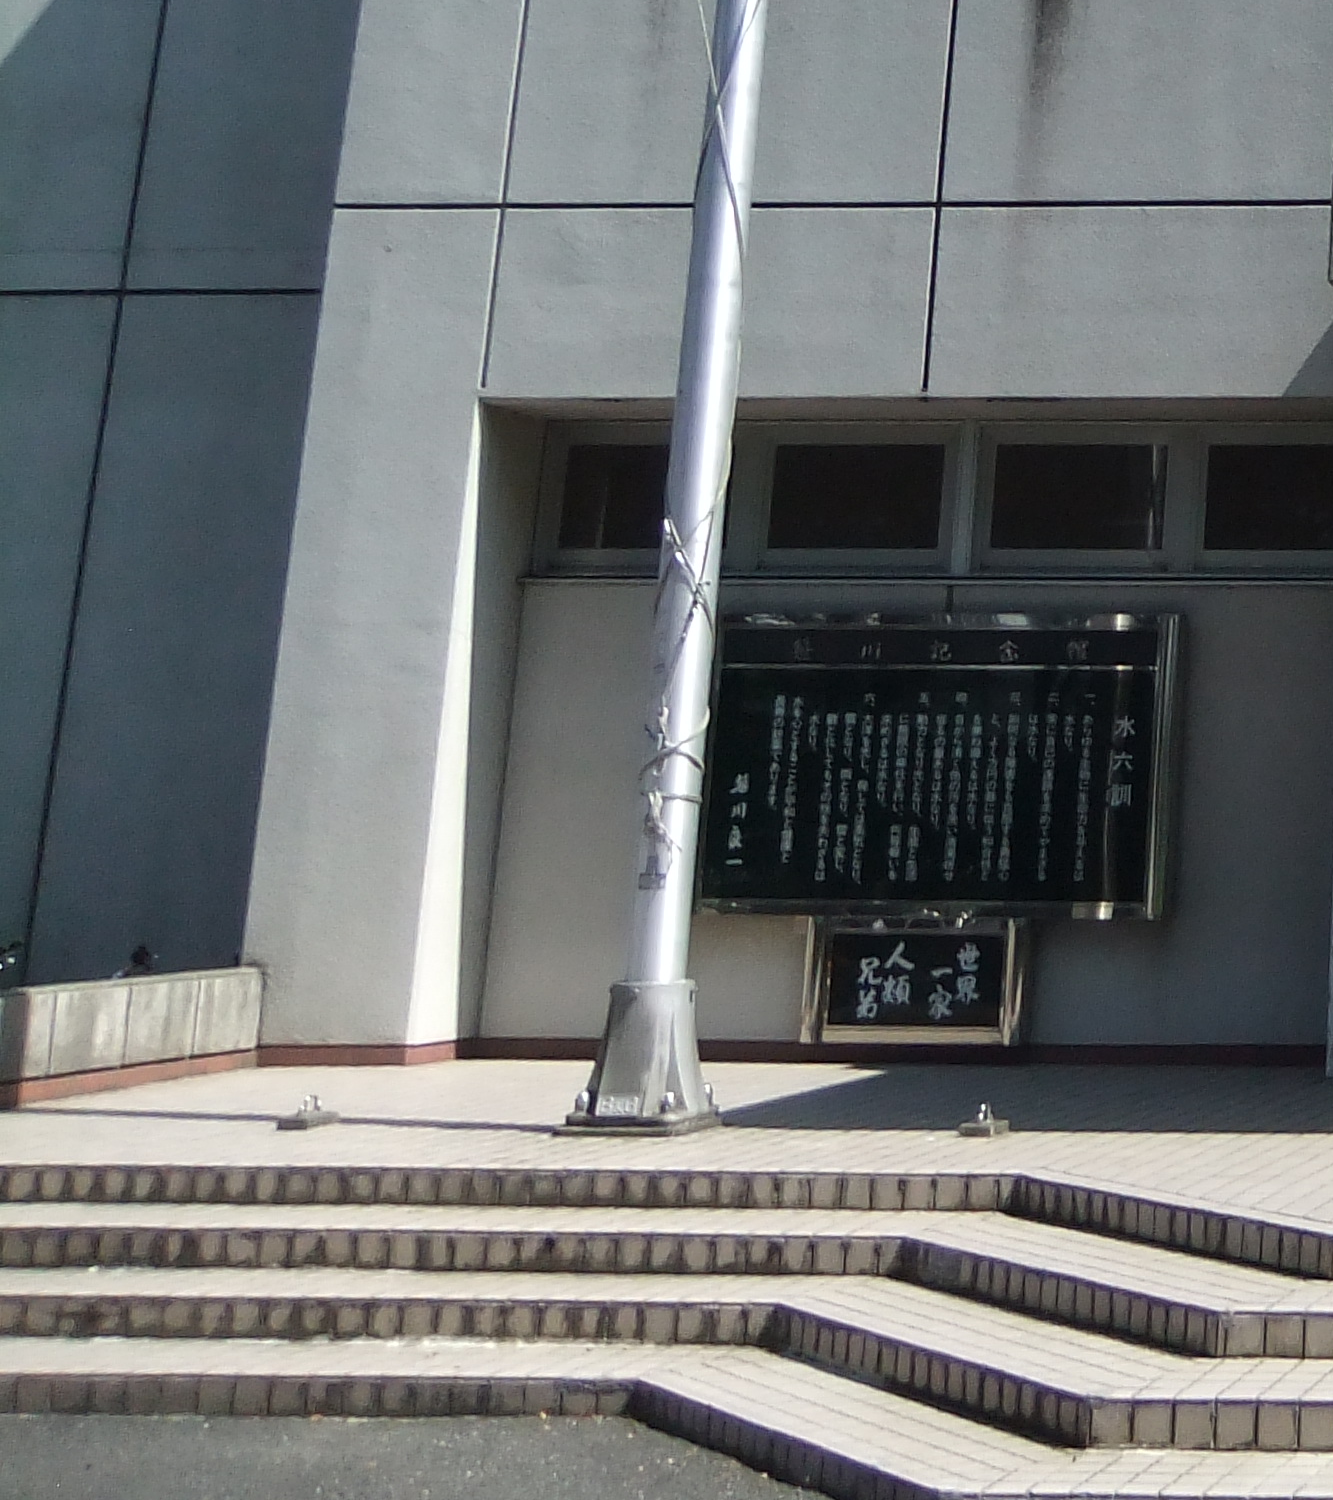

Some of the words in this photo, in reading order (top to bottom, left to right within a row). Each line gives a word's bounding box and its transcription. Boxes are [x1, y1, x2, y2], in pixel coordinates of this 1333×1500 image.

[1110, 715, 1136, 806] 水六訓
[855, 956, 883, 1020] 兄弟
[881, 939, 916, 1005] 人類
[927, 966, 954, 1020] 一家
[955, 941, 982, 1005] 世界
